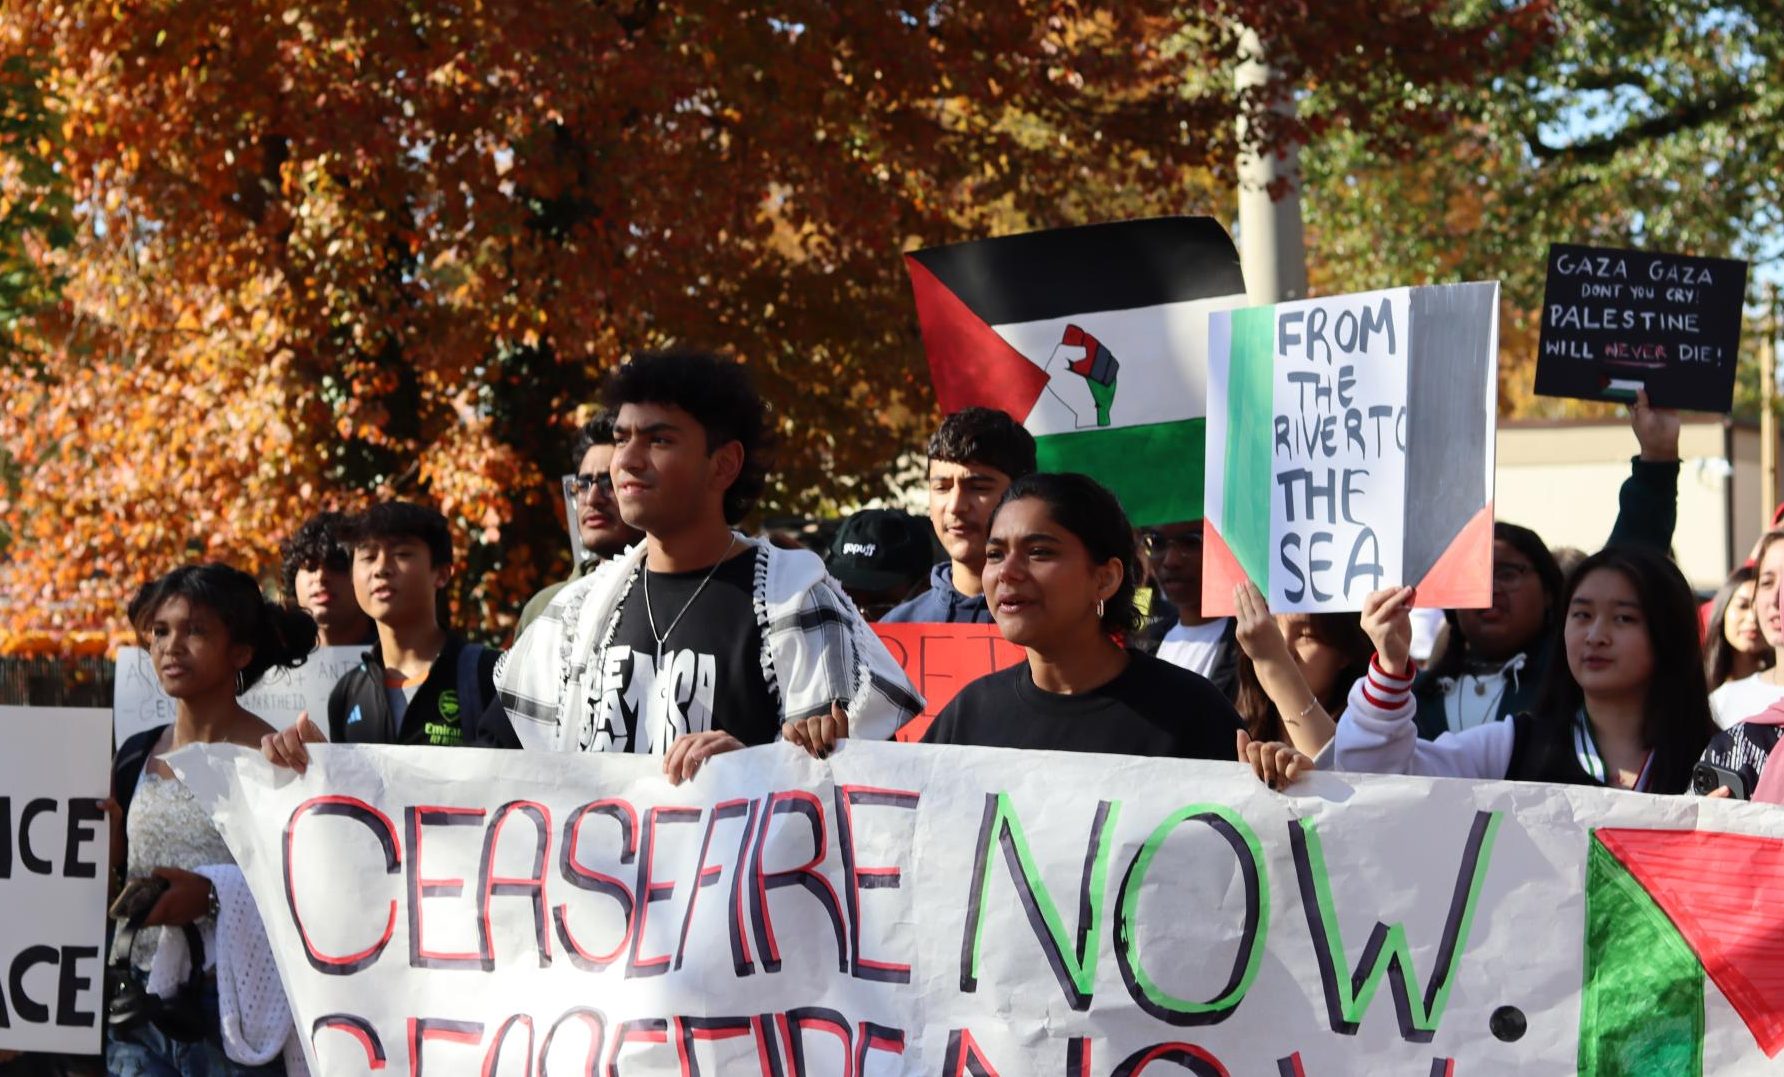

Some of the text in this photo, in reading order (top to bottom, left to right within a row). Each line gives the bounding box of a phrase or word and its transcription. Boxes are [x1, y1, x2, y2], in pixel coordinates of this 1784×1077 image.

[1556, 254, 1713, 286] GAZA GAZA
[1581, 283, 1624, 299] DONT
[1630, 286, 1655, 299] YOU
[1278, 297, 1396, 365] FROM
[1549, 304, 1700, 333] PALESTINE
[1545, 340, 1723, 367] WILL NEVER DIE!
[1287, 365, 1357, 414] THE
[1276, 467, 1371, 527] THE
[842, 542, 876, 557] gopuff
[1280, 526, 1384, 604] SEA
[281, 784, 920, 984] CEASEFIRE
